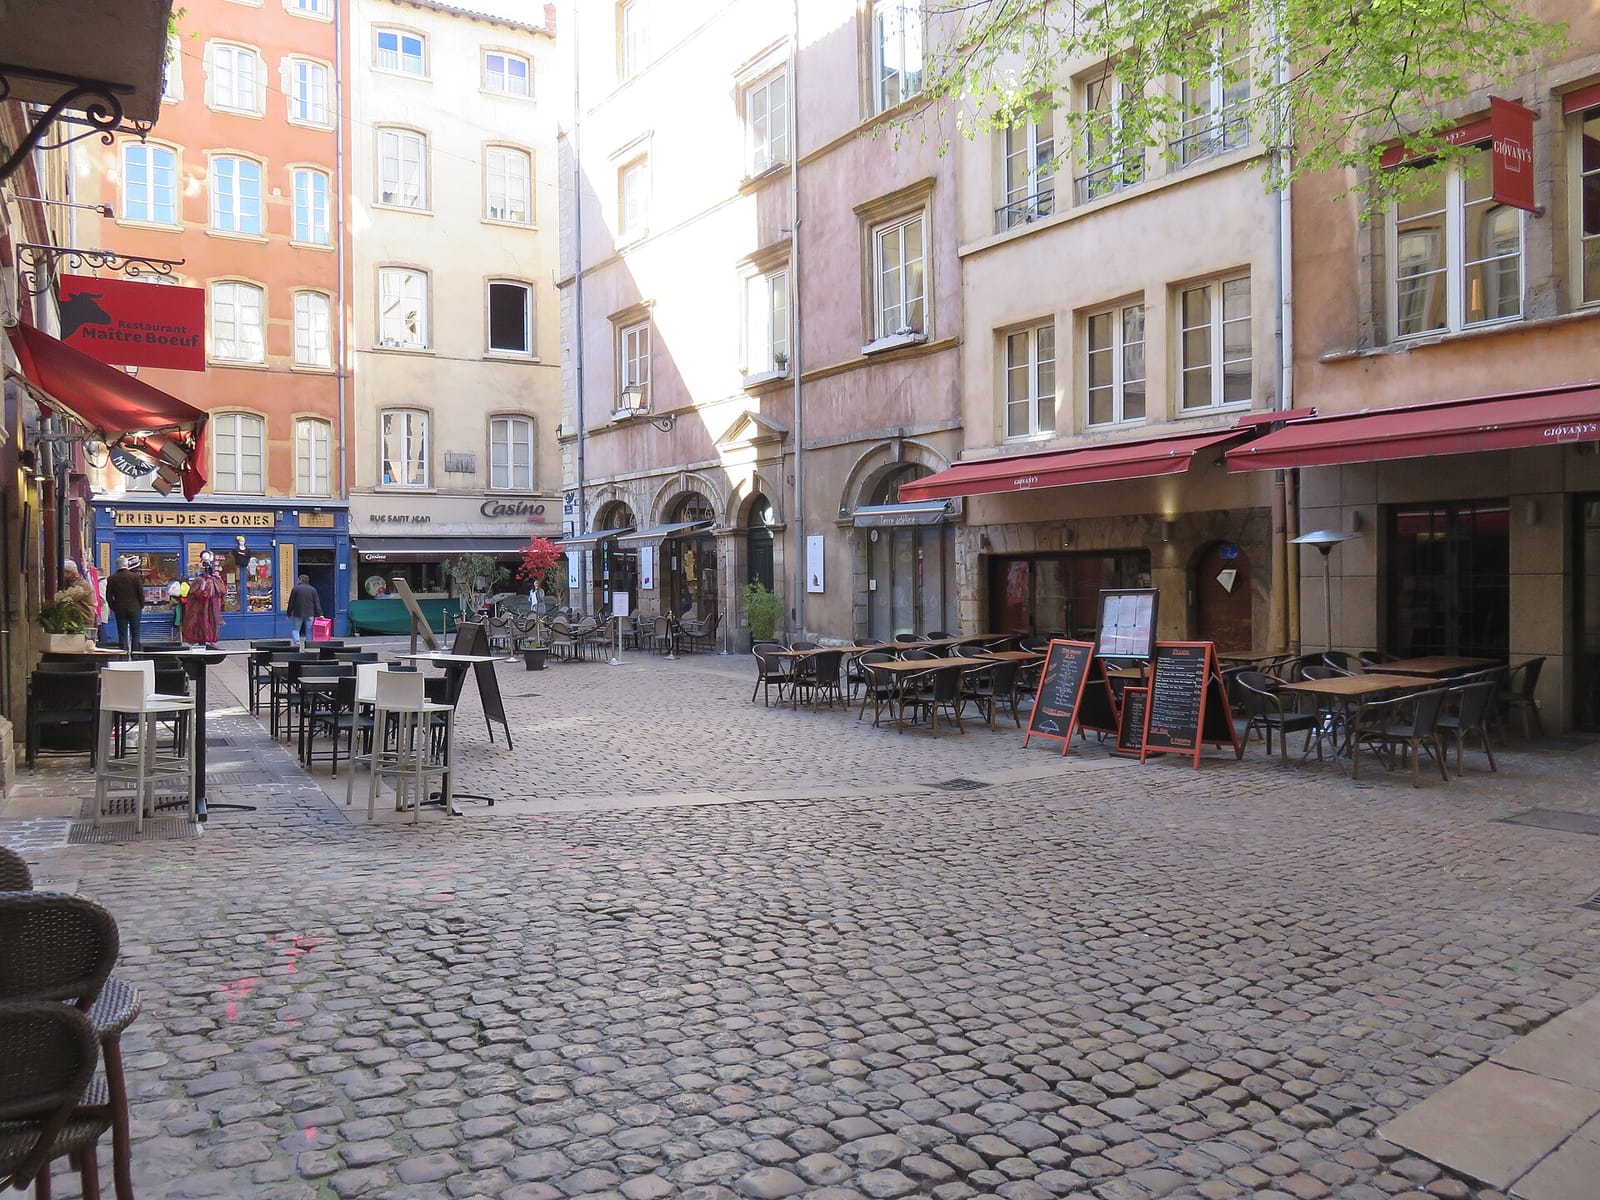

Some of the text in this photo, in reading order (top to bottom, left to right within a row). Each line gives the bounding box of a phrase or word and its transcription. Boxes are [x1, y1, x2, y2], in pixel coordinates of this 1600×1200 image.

[1493, 140, 1532, 163] GIOVANY'S
[117, 319, 188, 335] Restaurant
[82, 326, 200, 348] Maître Boeuf
[1543, 423, 1597, 438] GIOVANY'S
[480, 500, 546, 518] Casino
[369, 514, 431, 523] RUE SAINT JEAN
